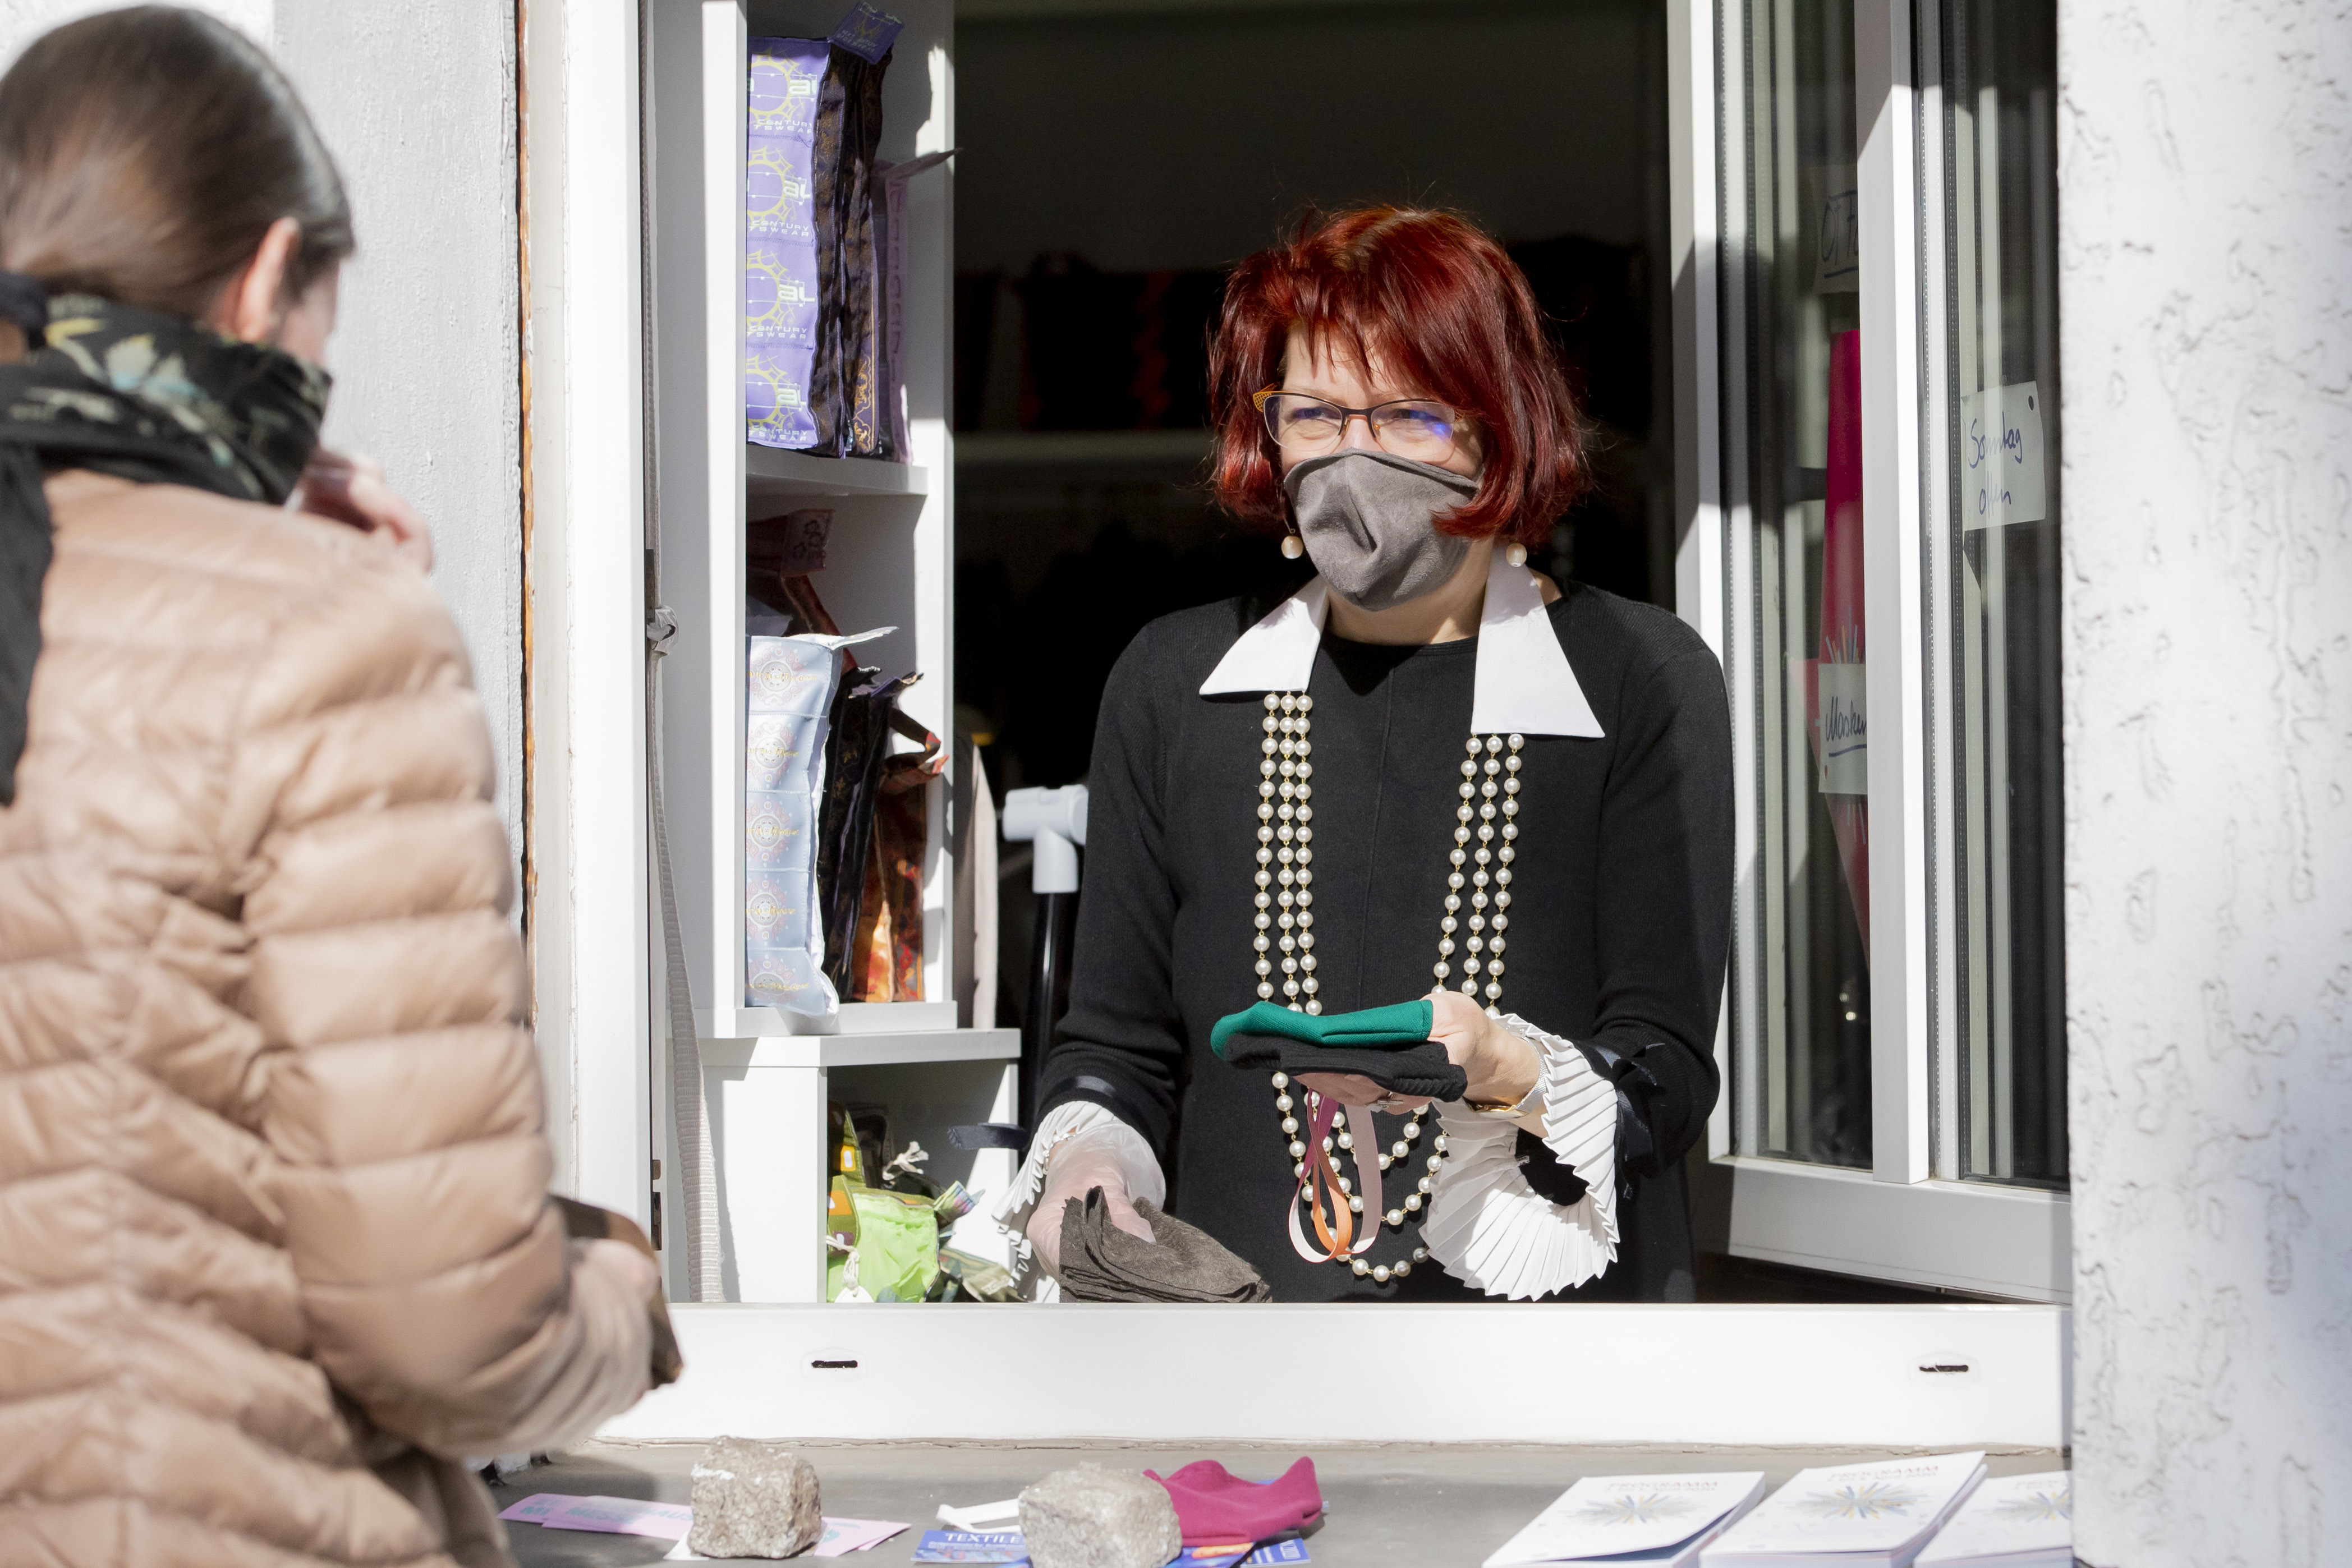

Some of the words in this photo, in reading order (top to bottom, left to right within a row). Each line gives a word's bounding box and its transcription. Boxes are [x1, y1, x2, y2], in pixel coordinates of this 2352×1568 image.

[752, 220, 809, 231] CENTURY
[1968, 411, 2023, 469] Sonntag
[945, 1533, 1022, 1543] TEXTILE
